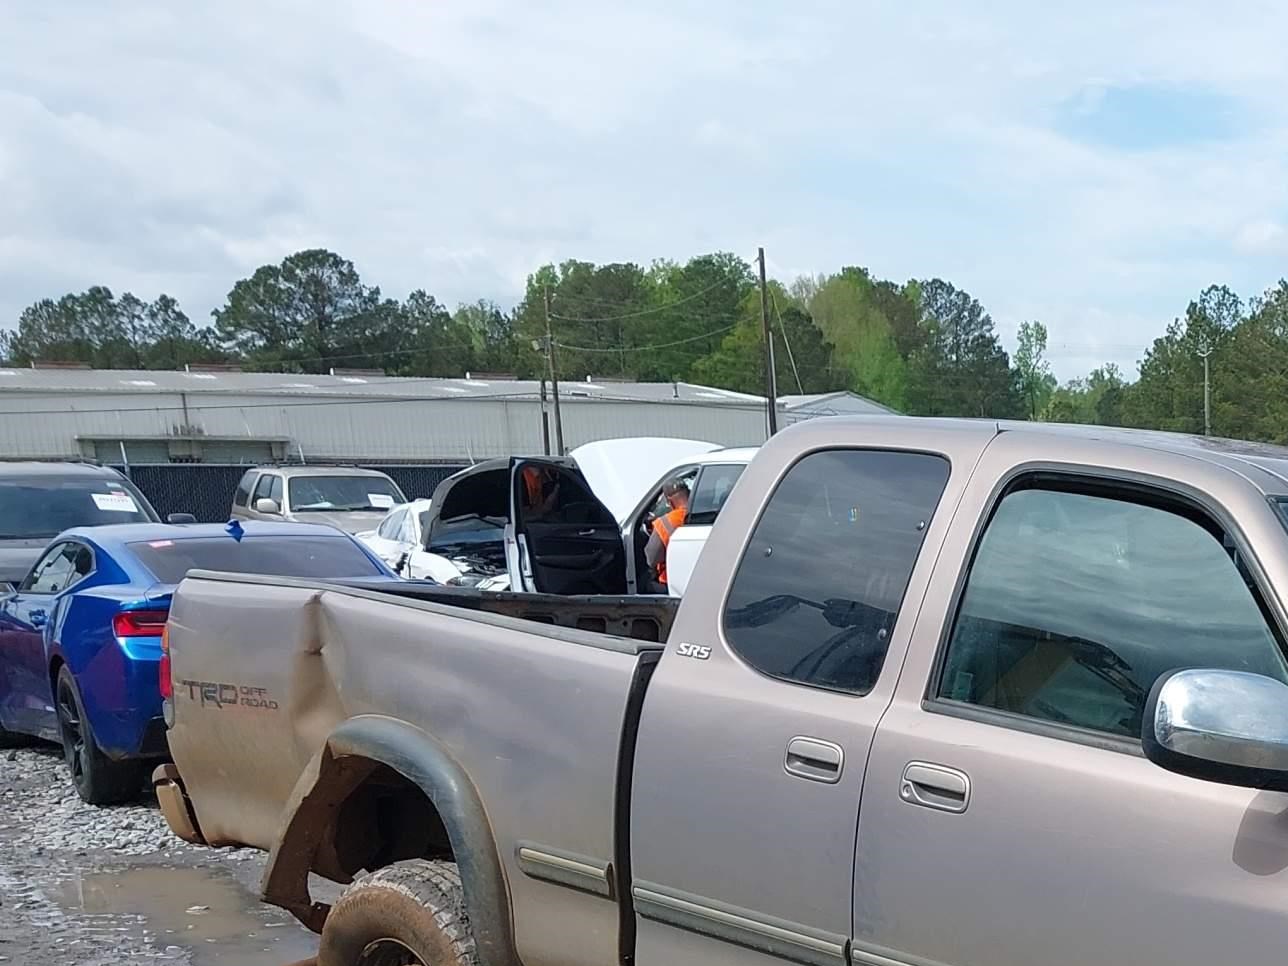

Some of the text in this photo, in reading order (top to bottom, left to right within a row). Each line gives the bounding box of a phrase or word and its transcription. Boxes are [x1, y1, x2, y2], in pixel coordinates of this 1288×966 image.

[676, 642, 712, 660] SR5
[182, 680, 239, 709] TRD
[240, 686, 267, 696] OFF
[240, 698, 279, 710] ROAD
